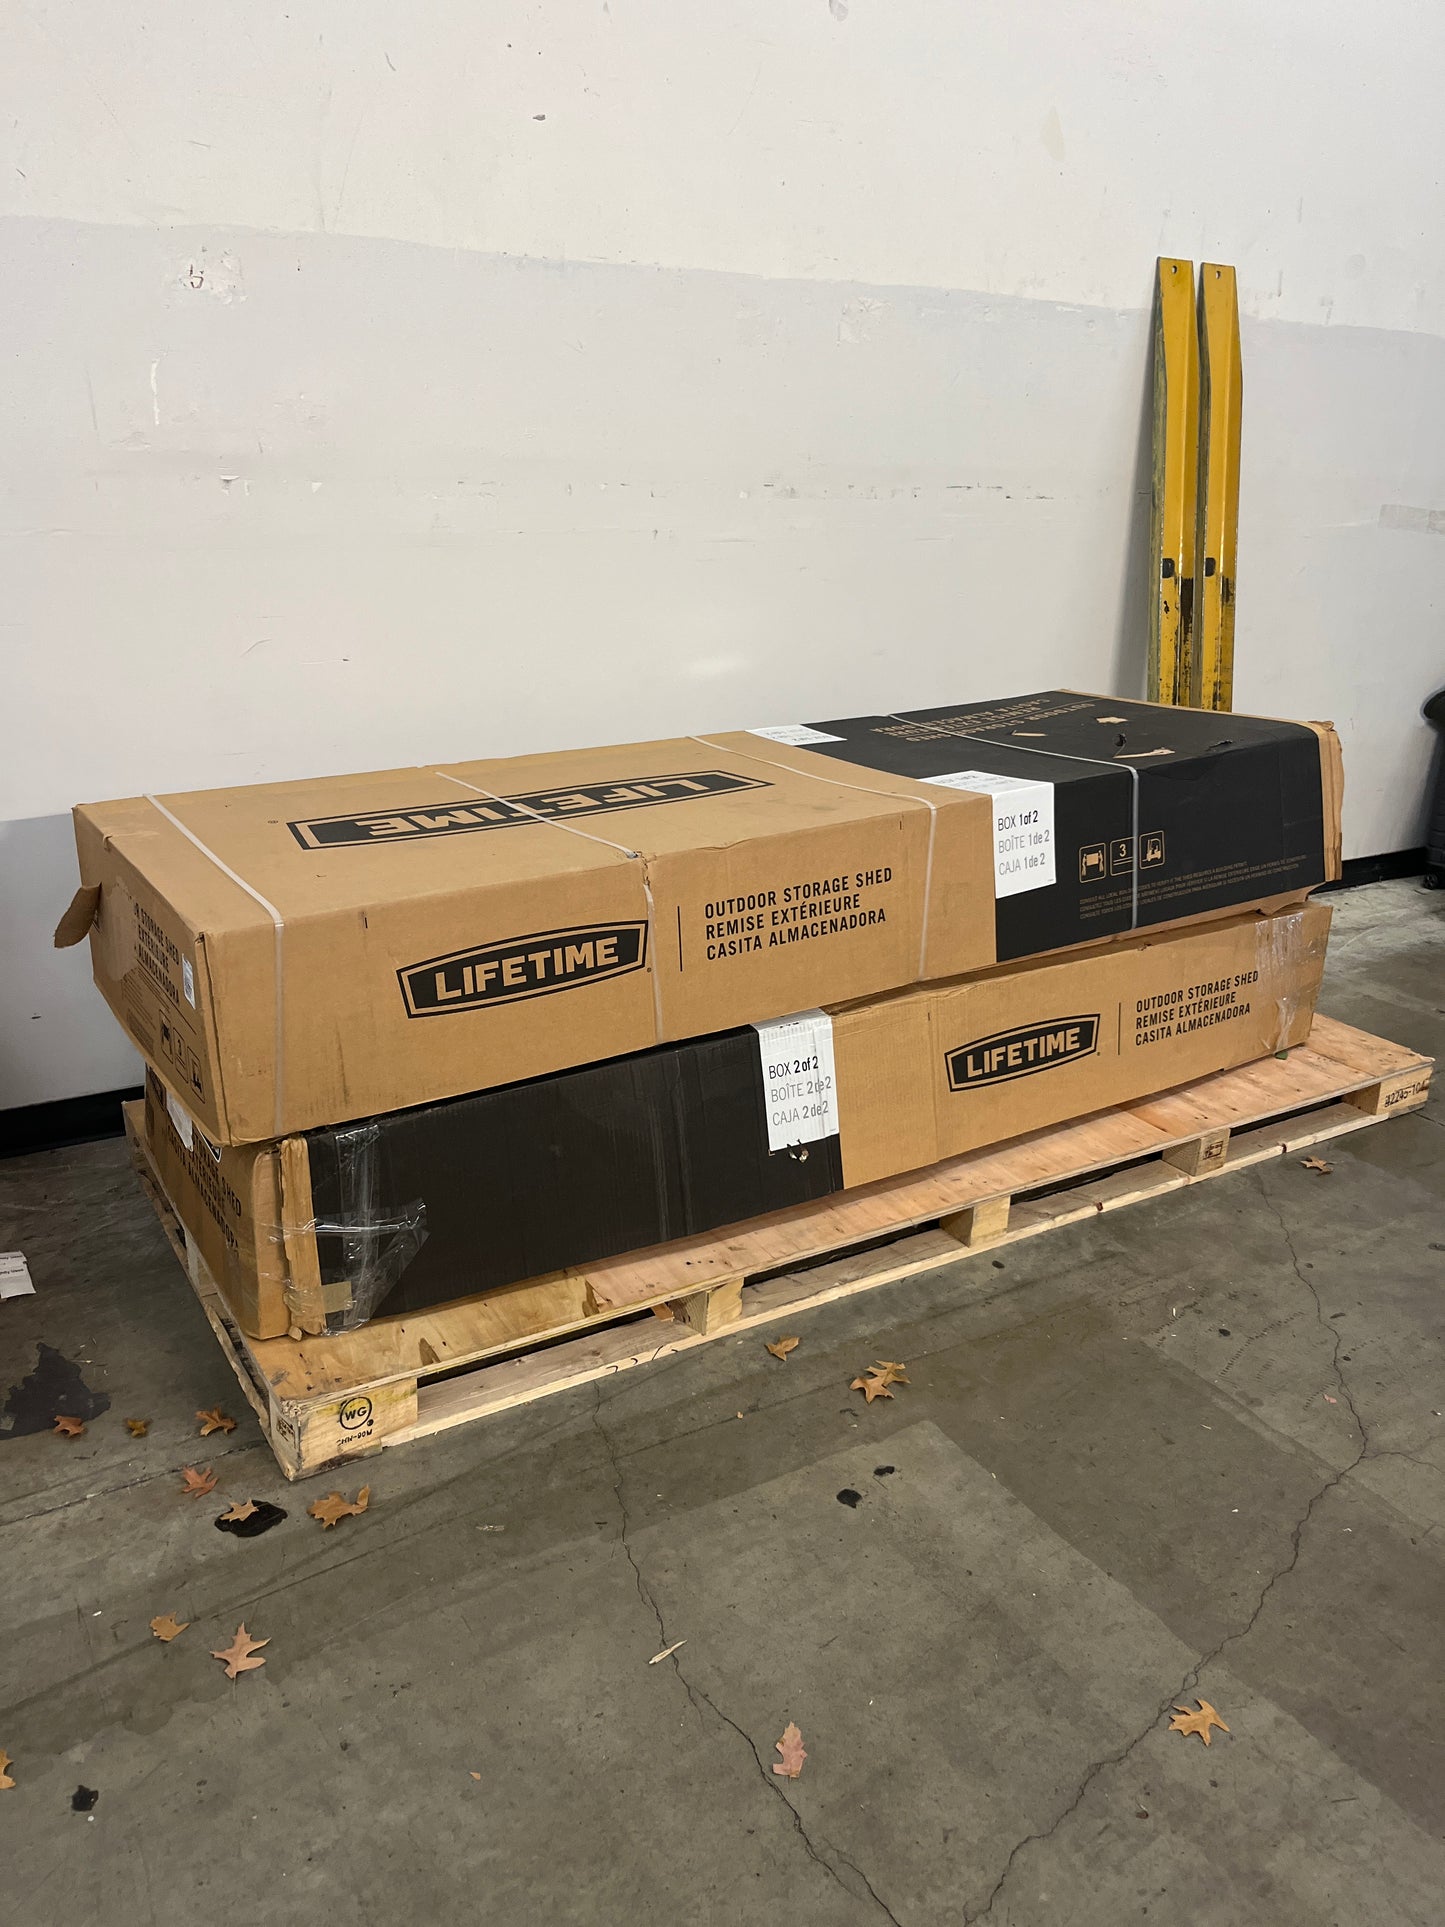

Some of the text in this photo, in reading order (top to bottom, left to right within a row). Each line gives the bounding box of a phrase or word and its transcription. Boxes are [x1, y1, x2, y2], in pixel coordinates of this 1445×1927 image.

[354, 779, 711, 837] LIFETIME
[998, 815, 1016, 831] BOX
[998, 834, 1025, 853] BOÎTE
[1119, 843, 1127, 857] 3
[998, 858, 1021, 876] CAJA
[705, 867, 892, 919] OUTDOOR STORAGE SHED
[706, 893, 860, 940] REMISE EXTÉRIEURE
[707, 908, 886, 961] CASITA ALMACENADORA
[165, 937, 179, 965] SHED
[435, 936, 619, 1001] LIFETIME
[1136, 970, 1259, 1013] OUTDOOR STORAGE SHED
[1136, 991, 1236, 1030] REMISE EXTÉRIEURE
[1136, 1003, 1250, 1046] CASITA ALMACENADORA
[769, 1061, 791, 1079] BOX
[967, 1027, 1080, 1078] LIFETIME
[771, 1082, 804, 1103] BOÎTE
[772, 1108, 800, 1126] CAJA
[221, 1176, 242, 1218] SHED
[345, 1406, 367, 1421] WG
